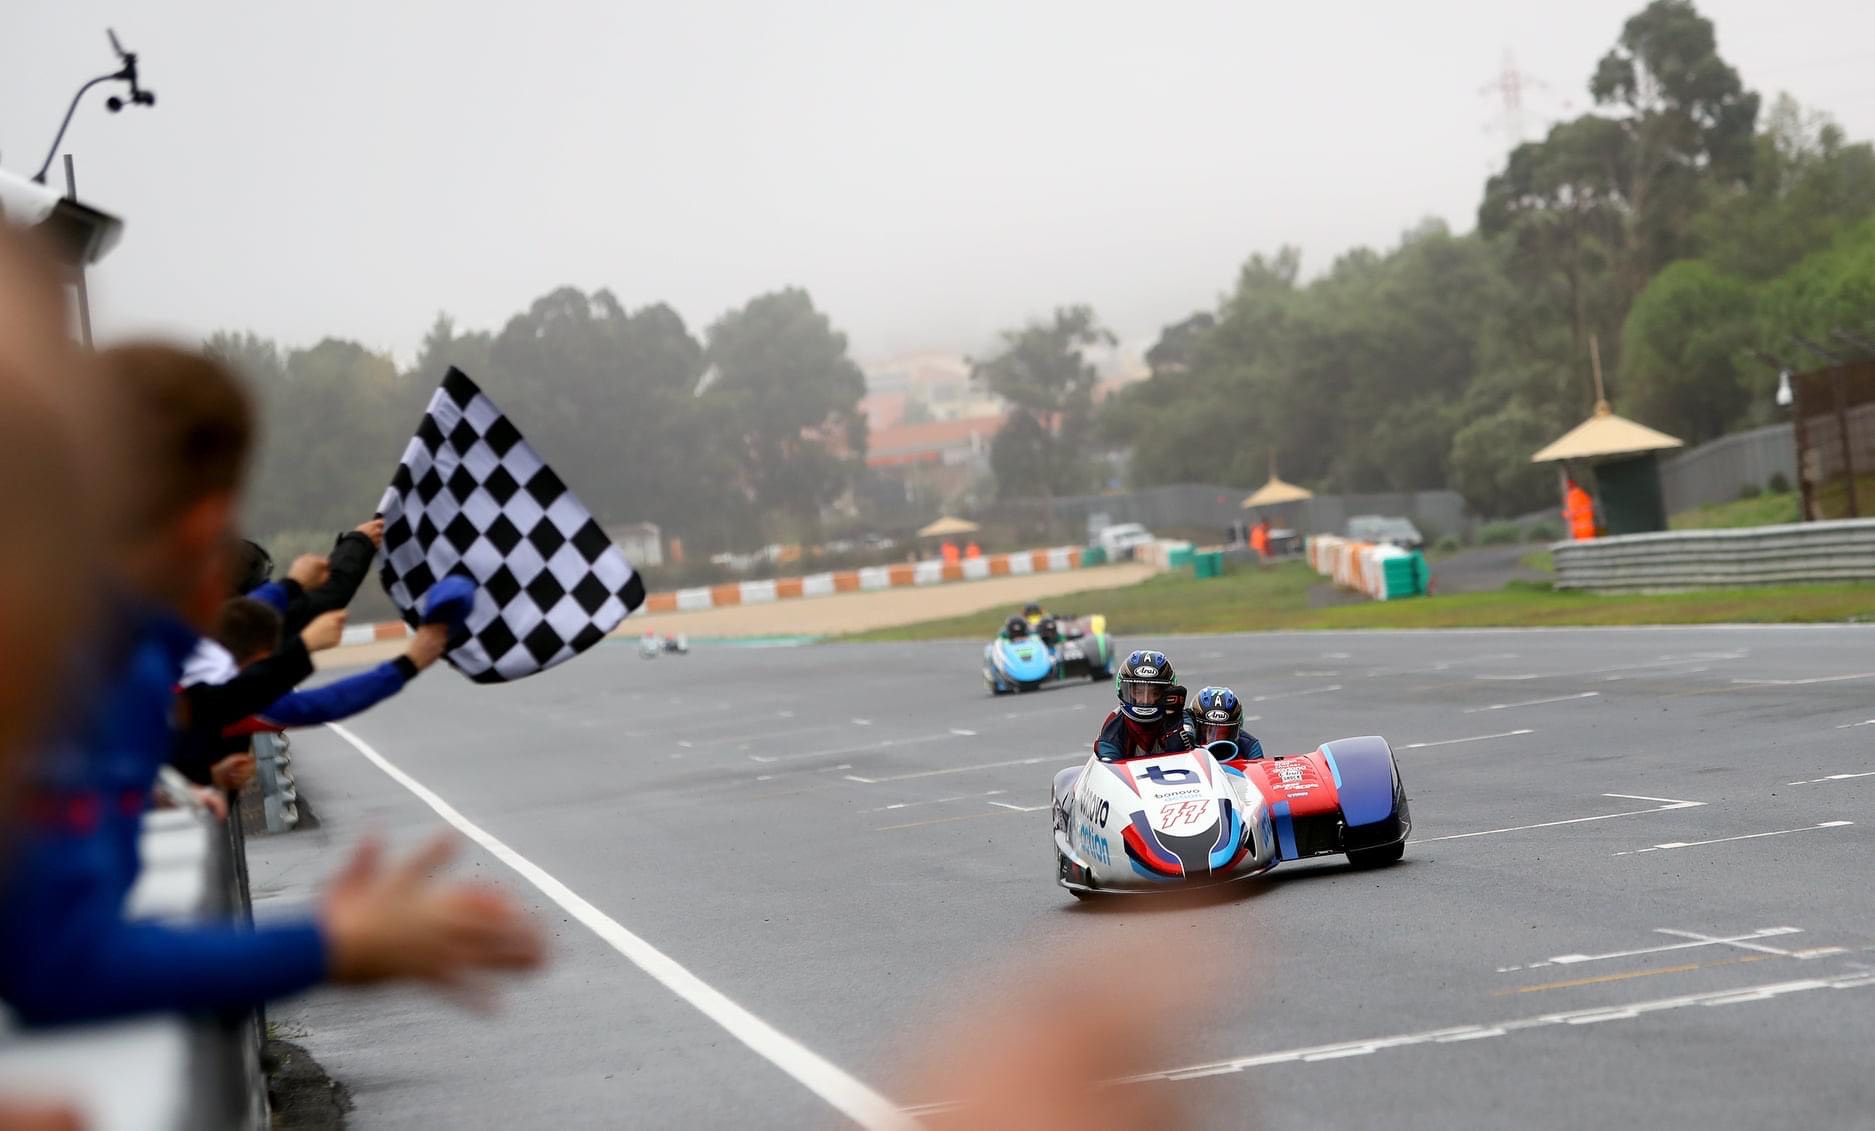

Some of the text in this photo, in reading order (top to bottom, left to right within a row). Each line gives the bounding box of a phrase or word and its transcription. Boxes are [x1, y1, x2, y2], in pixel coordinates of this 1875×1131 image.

[1136, 667, 1156, 675] Arai
[1214, 695, 1222, 707] A
[1208, 711, 1227, 719] Arai
[1159, 799, 1211, 830] 77
